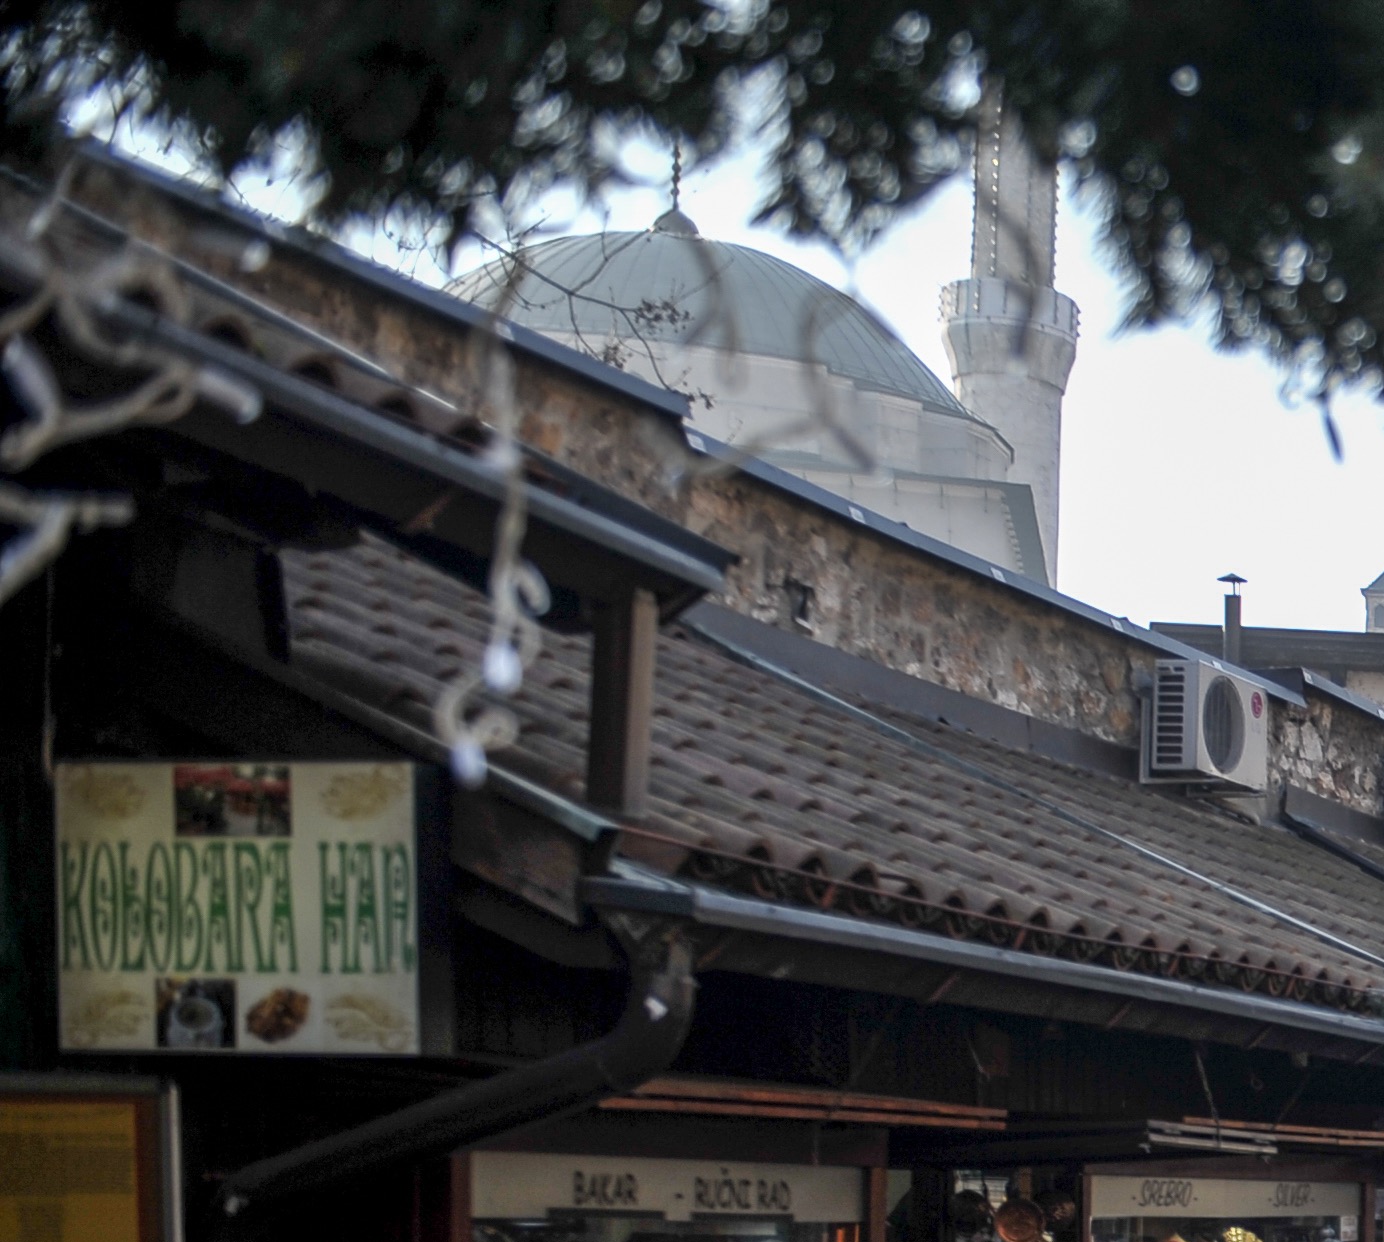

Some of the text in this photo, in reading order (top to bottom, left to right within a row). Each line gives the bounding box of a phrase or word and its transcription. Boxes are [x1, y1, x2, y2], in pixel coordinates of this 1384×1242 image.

[60, 841, 298, 973] KOLOBARA
[572, 1169, 639, 1206] BAKAR
[756, 1178, 792, 1211] RAD
